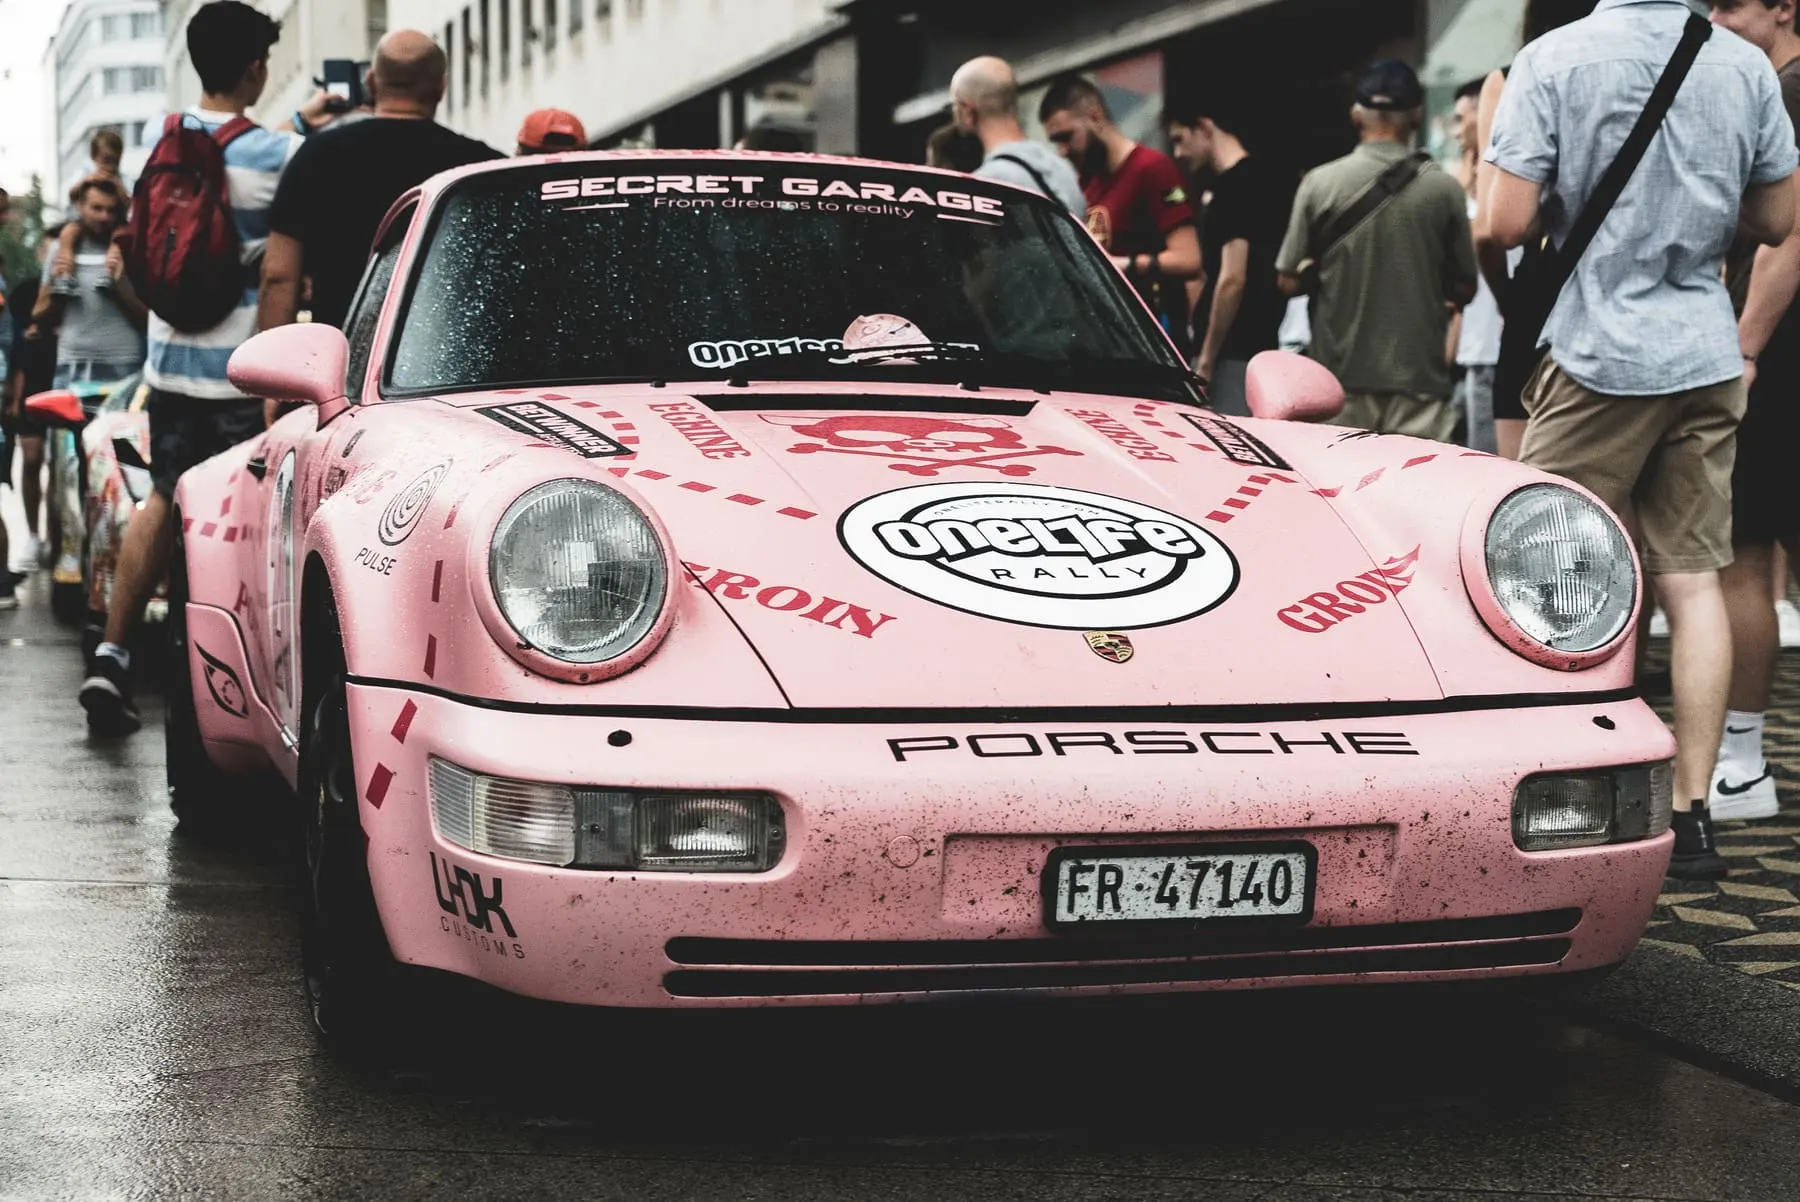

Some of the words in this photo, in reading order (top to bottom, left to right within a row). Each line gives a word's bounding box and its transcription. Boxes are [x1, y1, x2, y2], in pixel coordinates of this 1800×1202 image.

[540, 175, 764, 200] SECRET
[781, 177, 1005, 216] GARAGE
[653, 197, 715, 209] From
[721, 197, 811, 210] dreams
[817, 201, 840, 211] to
[846, 203, 914, 219] reality
[506, 403, 618, 454] BETWINNER
[646, 402, 751, 460] ECHINE
[355, 547, 397, 576] PULSE
[990, 567, 1147, 580] RALLY
[1277, 544, 1421, 633] GROIN
[885, 730, 1420, 762] PORSCHE
[1066, 863, 1124, 914] FR
[1154, 859, 1293, 911] 47140
[440, 916, 526, 959] CUSTOMS
